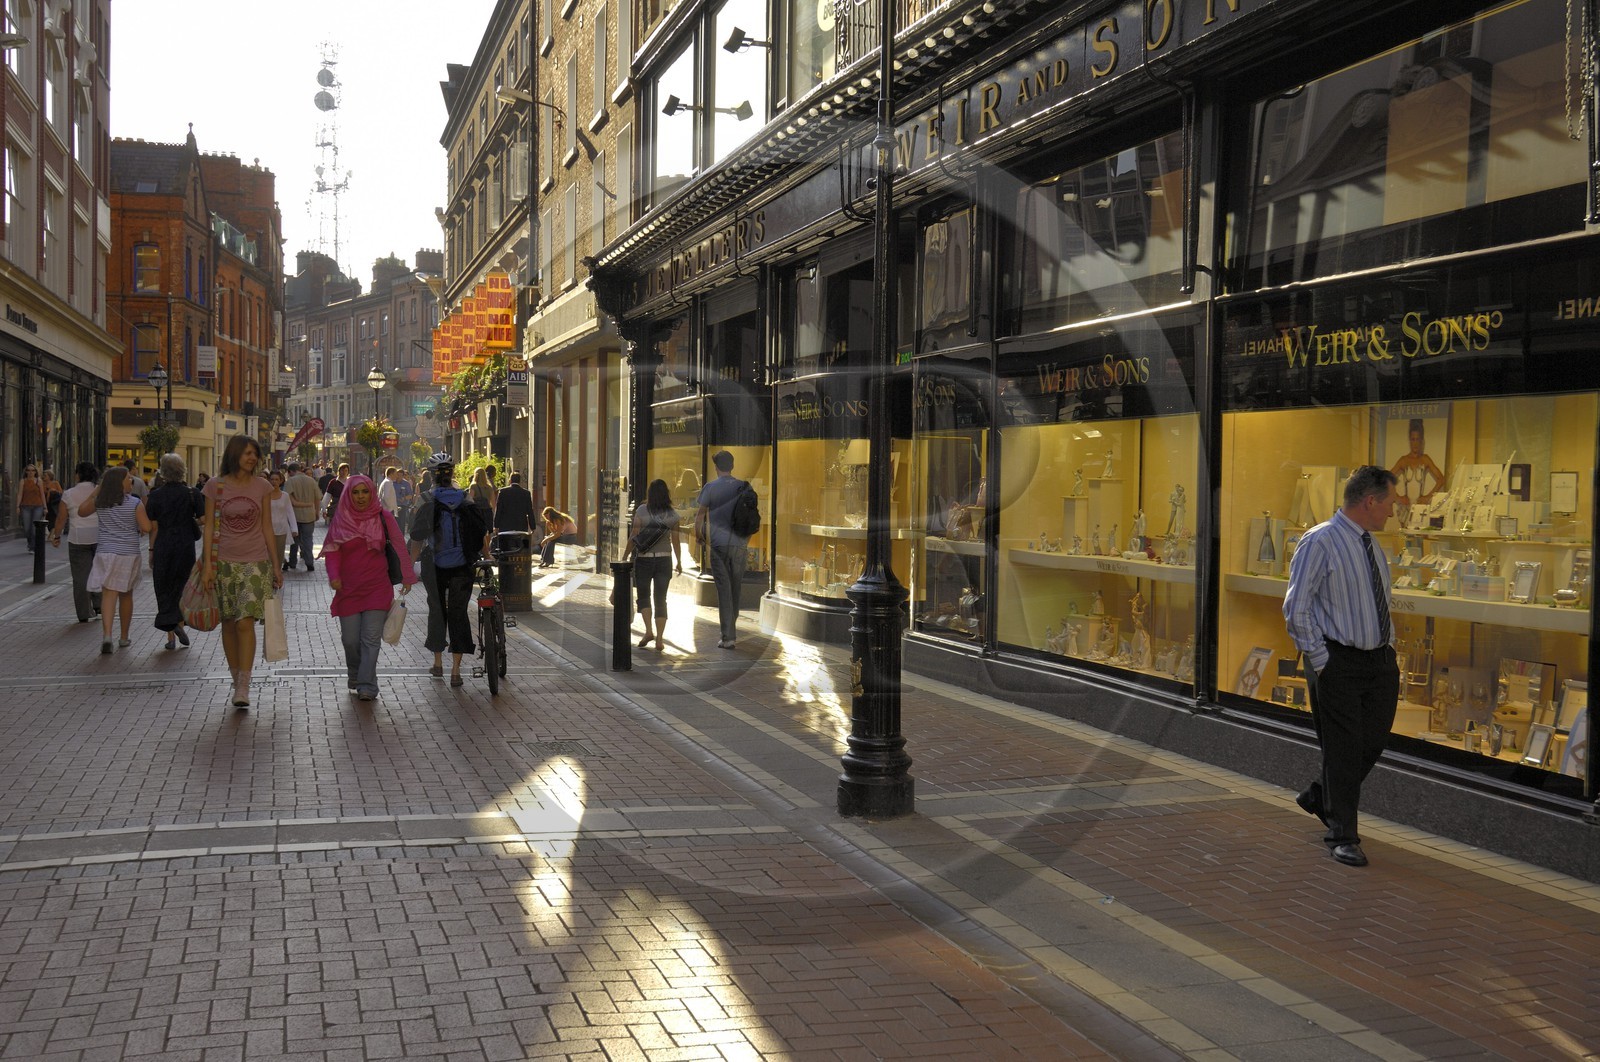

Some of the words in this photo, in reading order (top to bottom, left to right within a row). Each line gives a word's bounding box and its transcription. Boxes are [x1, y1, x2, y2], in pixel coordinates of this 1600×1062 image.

[895, 82, 1002, 170] WEIR
[1015, 58, 1070, 107] AND
[645, 210, 767, 297] JEWELLERS
[488, 313, 511, 325] NO
[1281, 324, 1360, 369] WEIR
[1366, 327, 1393, 361] &
[1401, 311, 1490, 357] SONS
[510, 372, 527, 381] AIB
[1037, 362, 1081, 394] WEIR
[1084, 365, 1098, 389] &
[1103, 354, 1150, 387] SONS
[925, 374, 957, 407] SONS
[823, 396, 869, 417] SONS
[1387, 403, 1440, 417] JEWELLERY
[1391, 597, 1416, 611] SONS
